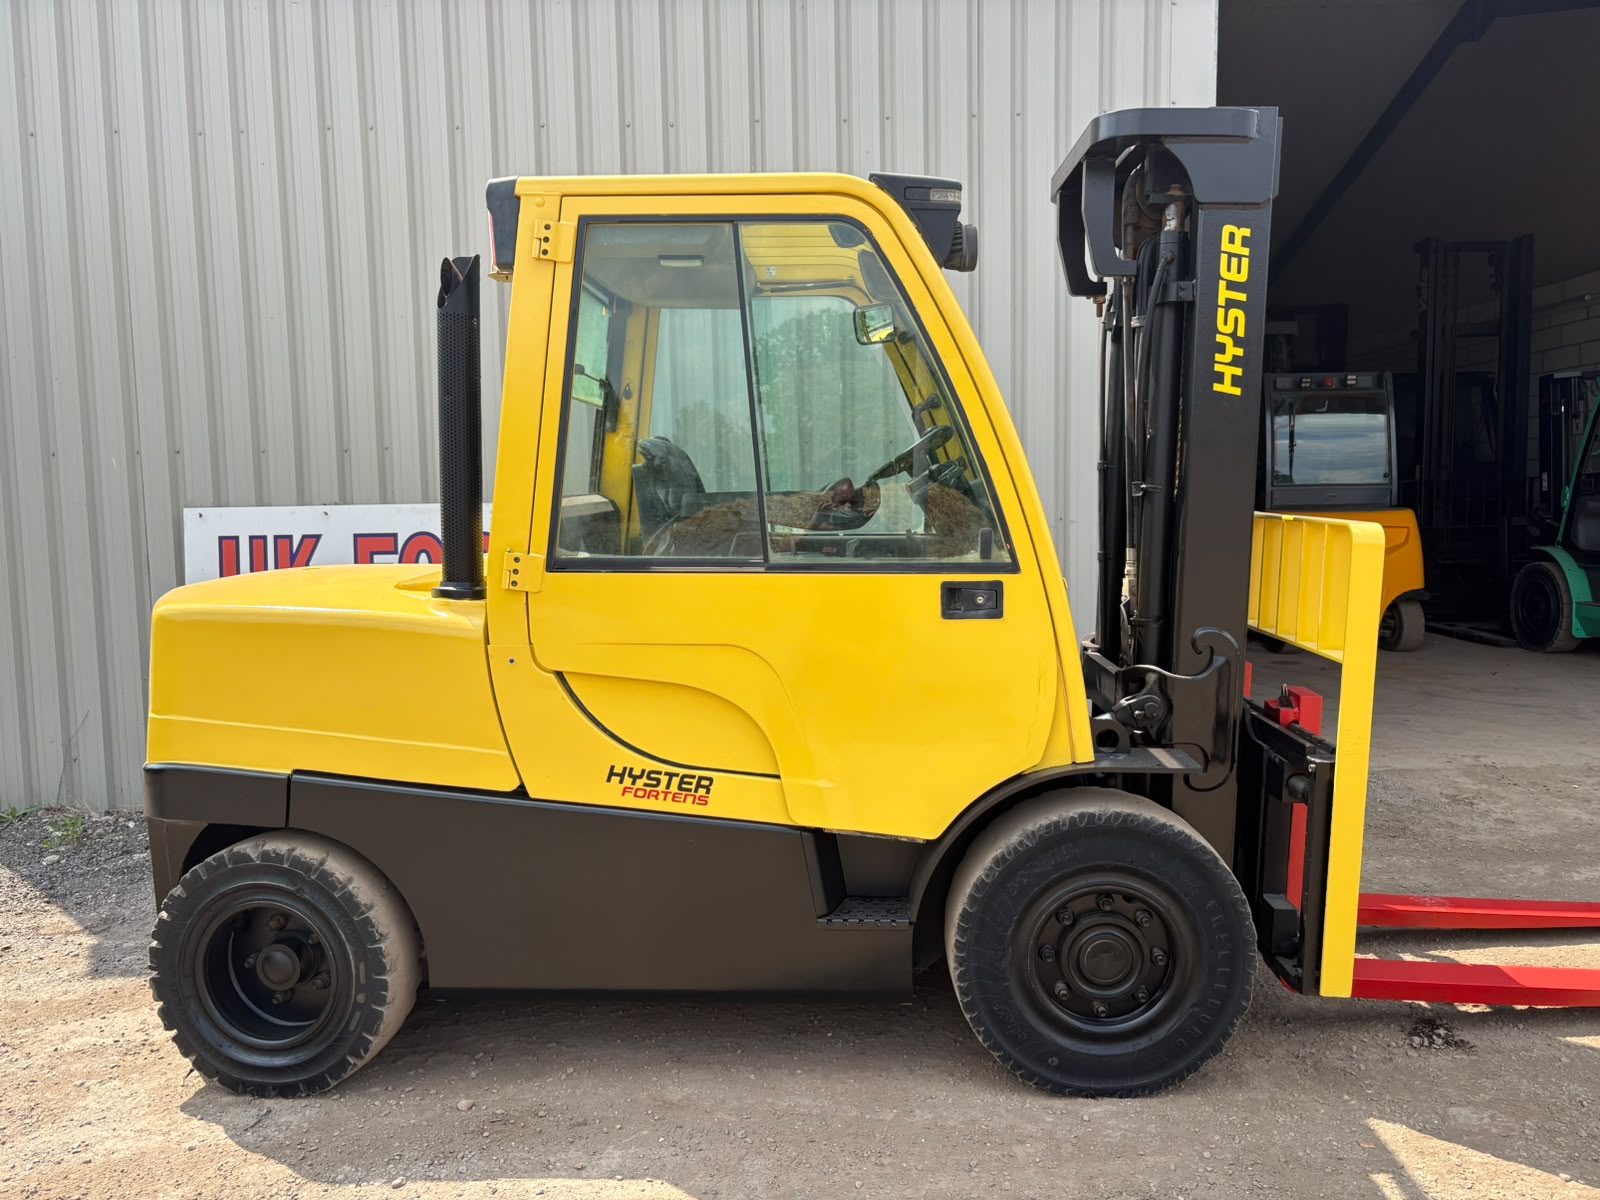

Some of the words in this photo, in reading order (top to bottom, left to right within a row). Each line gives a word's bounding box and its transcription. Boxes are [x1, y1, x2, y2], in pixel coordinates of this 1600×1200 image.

[1212, 224, 1251, 396] HYSTER
[218, 533, 323, 578] UK
[606, 764, 714, 795] HYSTER
[621, 786, 709, 806] FORTENS
